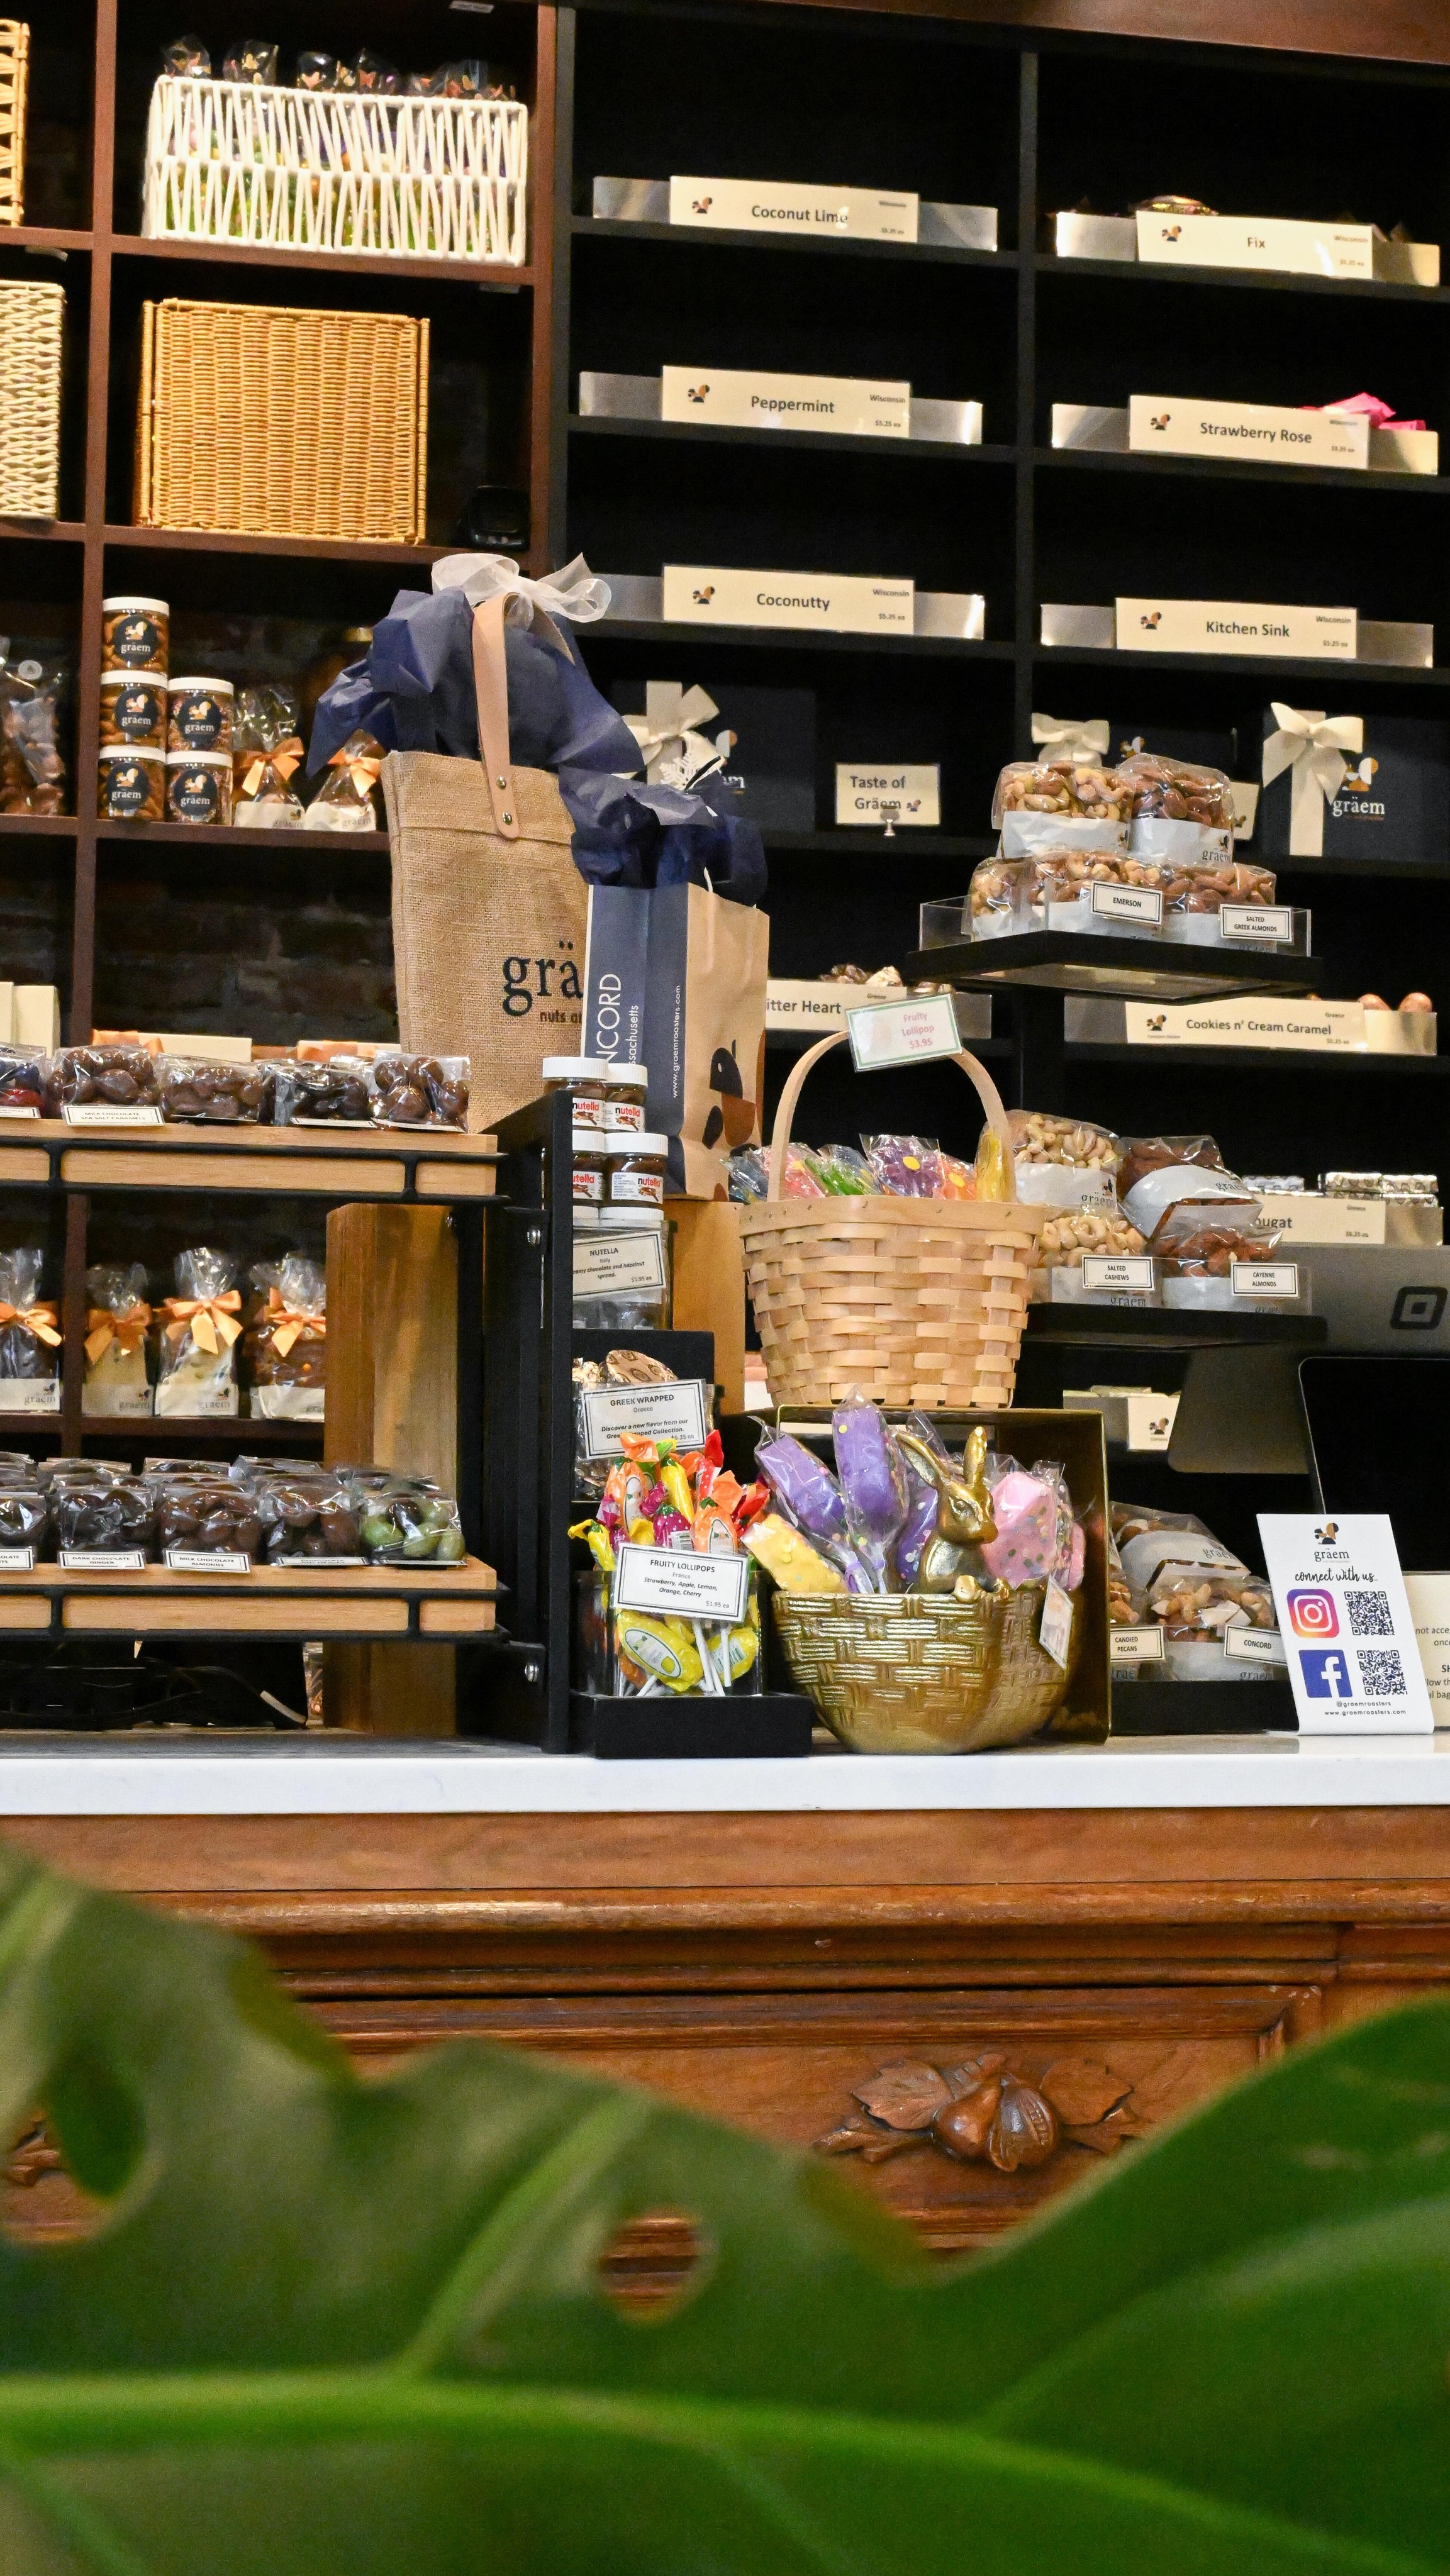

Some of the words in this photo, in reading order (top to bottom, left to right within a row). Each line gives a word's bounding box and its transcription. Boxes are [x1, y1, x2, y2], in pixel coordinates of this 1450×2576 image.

[751, 205, 811, 221] Coconut
[815, 210, 848, 223] Lime
[1247, 236, 1266, 248] Fix
[751, 396, 834, 413] Peppermint
[1200, 422, 1276, 442] Strawberry
[1280, 429, 1312, 443] Rose
[873, 588, 910, 597] Wisconsin
[757, 593, 830, 611] Coconutty
[1206, 621, 1258, 635] Kitchen
[1262, 624, 1290, 637] Sink
[849, 775, 888, 789] Taste
[891, 775, 906, 789] of
[1332, 796, 1385, 816] gräem
[1112, 897, 1142, 908] EMERSON
[1251, 924, 1278, 933] ALMONDS
[766, 999, 797, 1012] itter
[802, 1001, 841, 1014] Heart
[540, 1009, 566, 1023] nuts
[903, 1012, 928, 1023] Fruity
[901, 1024, 935, 1037] Lollipop
[1186, 1019, 1230, 1030] Cookies
[1248, 1021, 1283, 1032] Cream
[1287, 1023, 1331, 1035] Caramel
[672, 985, 681, 1098] www.graemroasters.com
[910, 1038, 933, 1050] $3.95
[572, 1101, 600, 1111] nutella
[615, 1107, 640, 1118] nutella
[638, 1177, 661, 1187] nutella
[589, 1248, 619, 1257] NUTELLA
[598, 1271, 616, 1280] spread.
[610, 1398, 635, 1406] GREEK
[637, 1394, 674, 1404] WRAPPED
[601, 1424, 630, 1433] Discover
[1314, 1548, 1350, 1562] gräem
[650, 1559, 676, 1568] FRUITY
[678, 1563, 715, 1573] LOLLIPOPS
[1295, 1567, 1334, 1582] connect
[1336, 1565, 1360, 1582] with
[644, 1577, 677, 1587] Strawberry,
[697, 1583, 718, 1592] Lemon,
[659, 1587, 682, 1596] Orange,
[683, 1590, 702, 1598] Cherry
[1244, 1639, 1272, 1650] CONCORD
